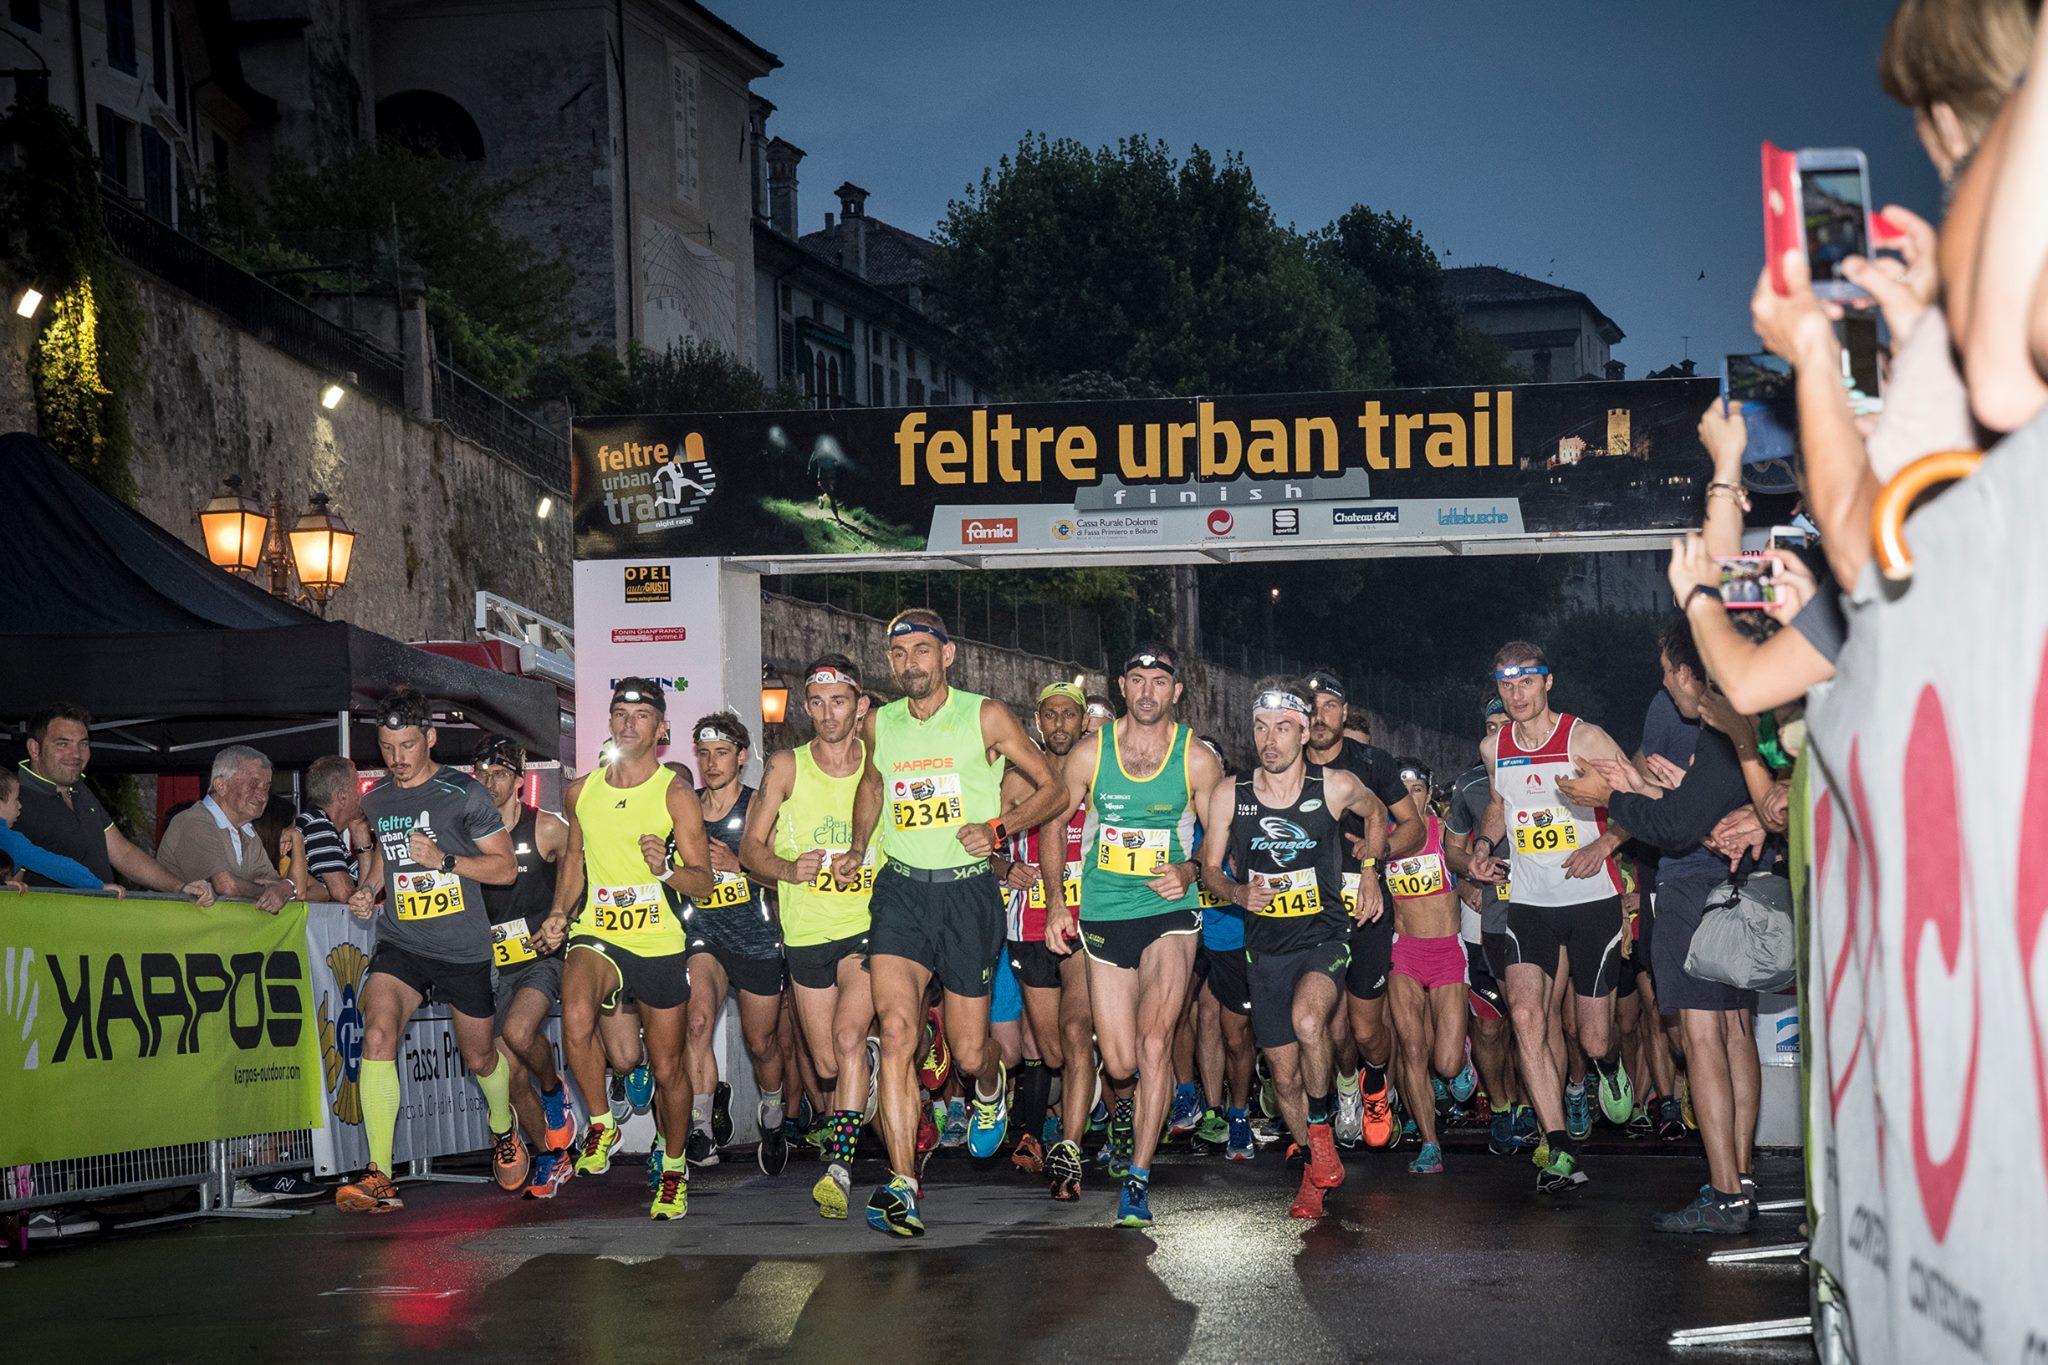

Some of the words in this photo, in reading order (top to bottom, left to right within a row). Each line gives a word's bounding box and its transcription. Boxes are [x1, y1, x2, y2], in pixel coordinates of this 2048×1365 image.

[894, 410, 1098, 486] feltre
[1118, 401, 1339, 479] urban
[1358, 390, 1513, 470] trail
[597, 441, 670, 472] feltre
[602, 472, 651, 491] urban
[603, 480, 677, 525] trail
[1113, 483, 1302, 505] finish
[655, 519, 675, 529] night
[675, 517, 692, 526] race
[1077, 519, 1098, 528] Cassa
[1100, 518, 1124, 527] Rurale
[1125, 517, 1158, 527] Dolomiti
[1334, 511, 1374, 523] Chateau
[966, 521, 1013, 542] famila
[625, 566, 670, 581] OPEL
[893, 757, 954, 773] KARPOS
[377, 815, 413, 833] feltre
[903, 802, 951, 828] 234
[380, 831, 404, 844] urban
[1250, 837, 1318, 851] Tornado
[1532, 829, 1558, 850] 69
[1127, 852, 1136, 871] 1
[1398, 875, 1433, 894] 109
[407, 892, 450, 917] 179
[605, 908, 648, 931] 207
[45, 951, 303, 1064] KARPOS
[234, 1061, 301, 1088] karpos-outdoor.com
